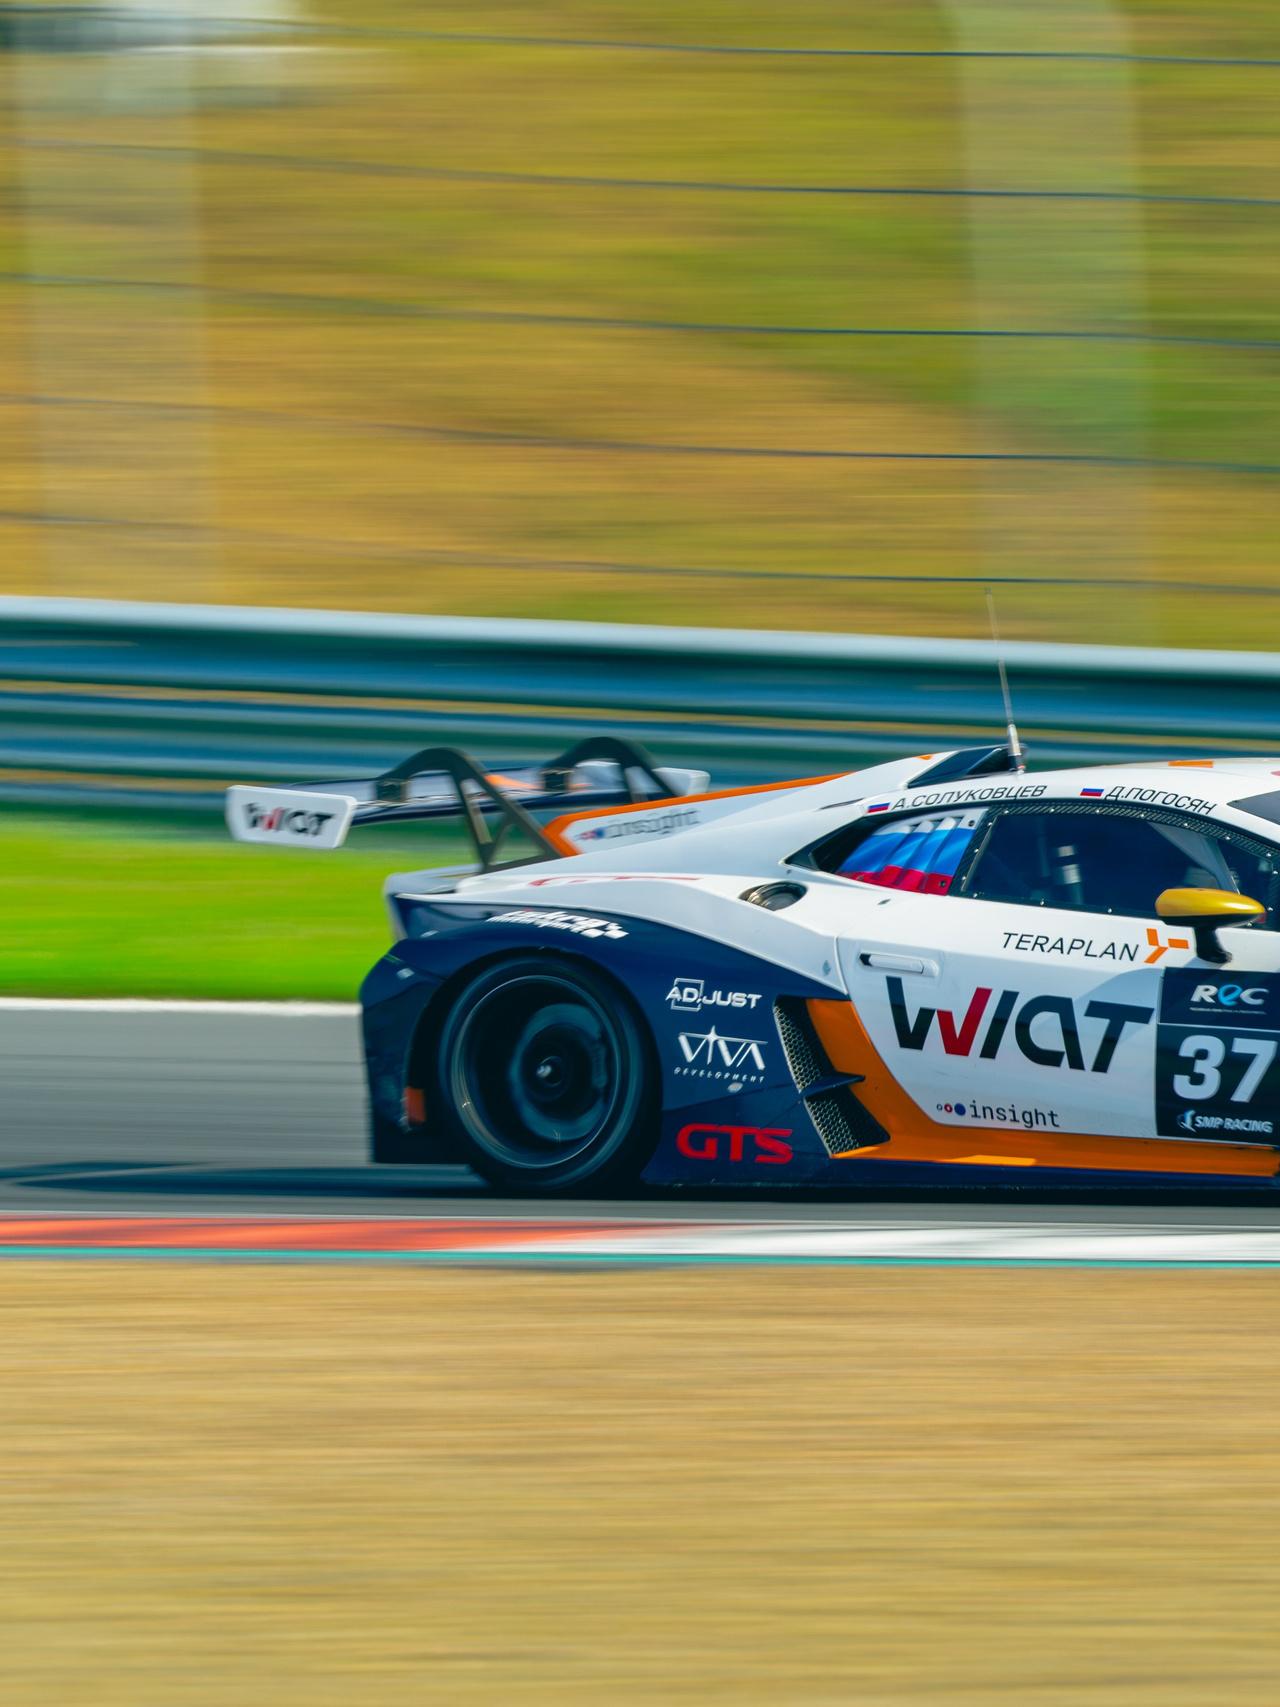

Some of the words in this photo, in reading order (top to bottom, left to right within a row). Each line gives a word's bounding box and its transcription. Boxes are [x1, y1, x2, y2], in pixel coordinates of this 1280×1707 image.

[891, 785, 1047, 810] А.СОЛУКОВЦЕВ
[1104, 785, 1217, 815] Д.ПОГОСЯН
[1002, 931, 1139, 962] TERAPLAN
[885, 975, 1155, 1074] WIAT
[678, 1024, 769, 1071] VIVA
[673, 1066, 766, 1084] DEVELOPMENT
[1172, 1034, 1279, 1104] 37
[970, 1099, 1060, 1129] insight
[1194, 1115, 1224, 1129] SMP
[1223, 1117, 1274, 1134] RACING
[676, 1122, 794, 1164] GTS
